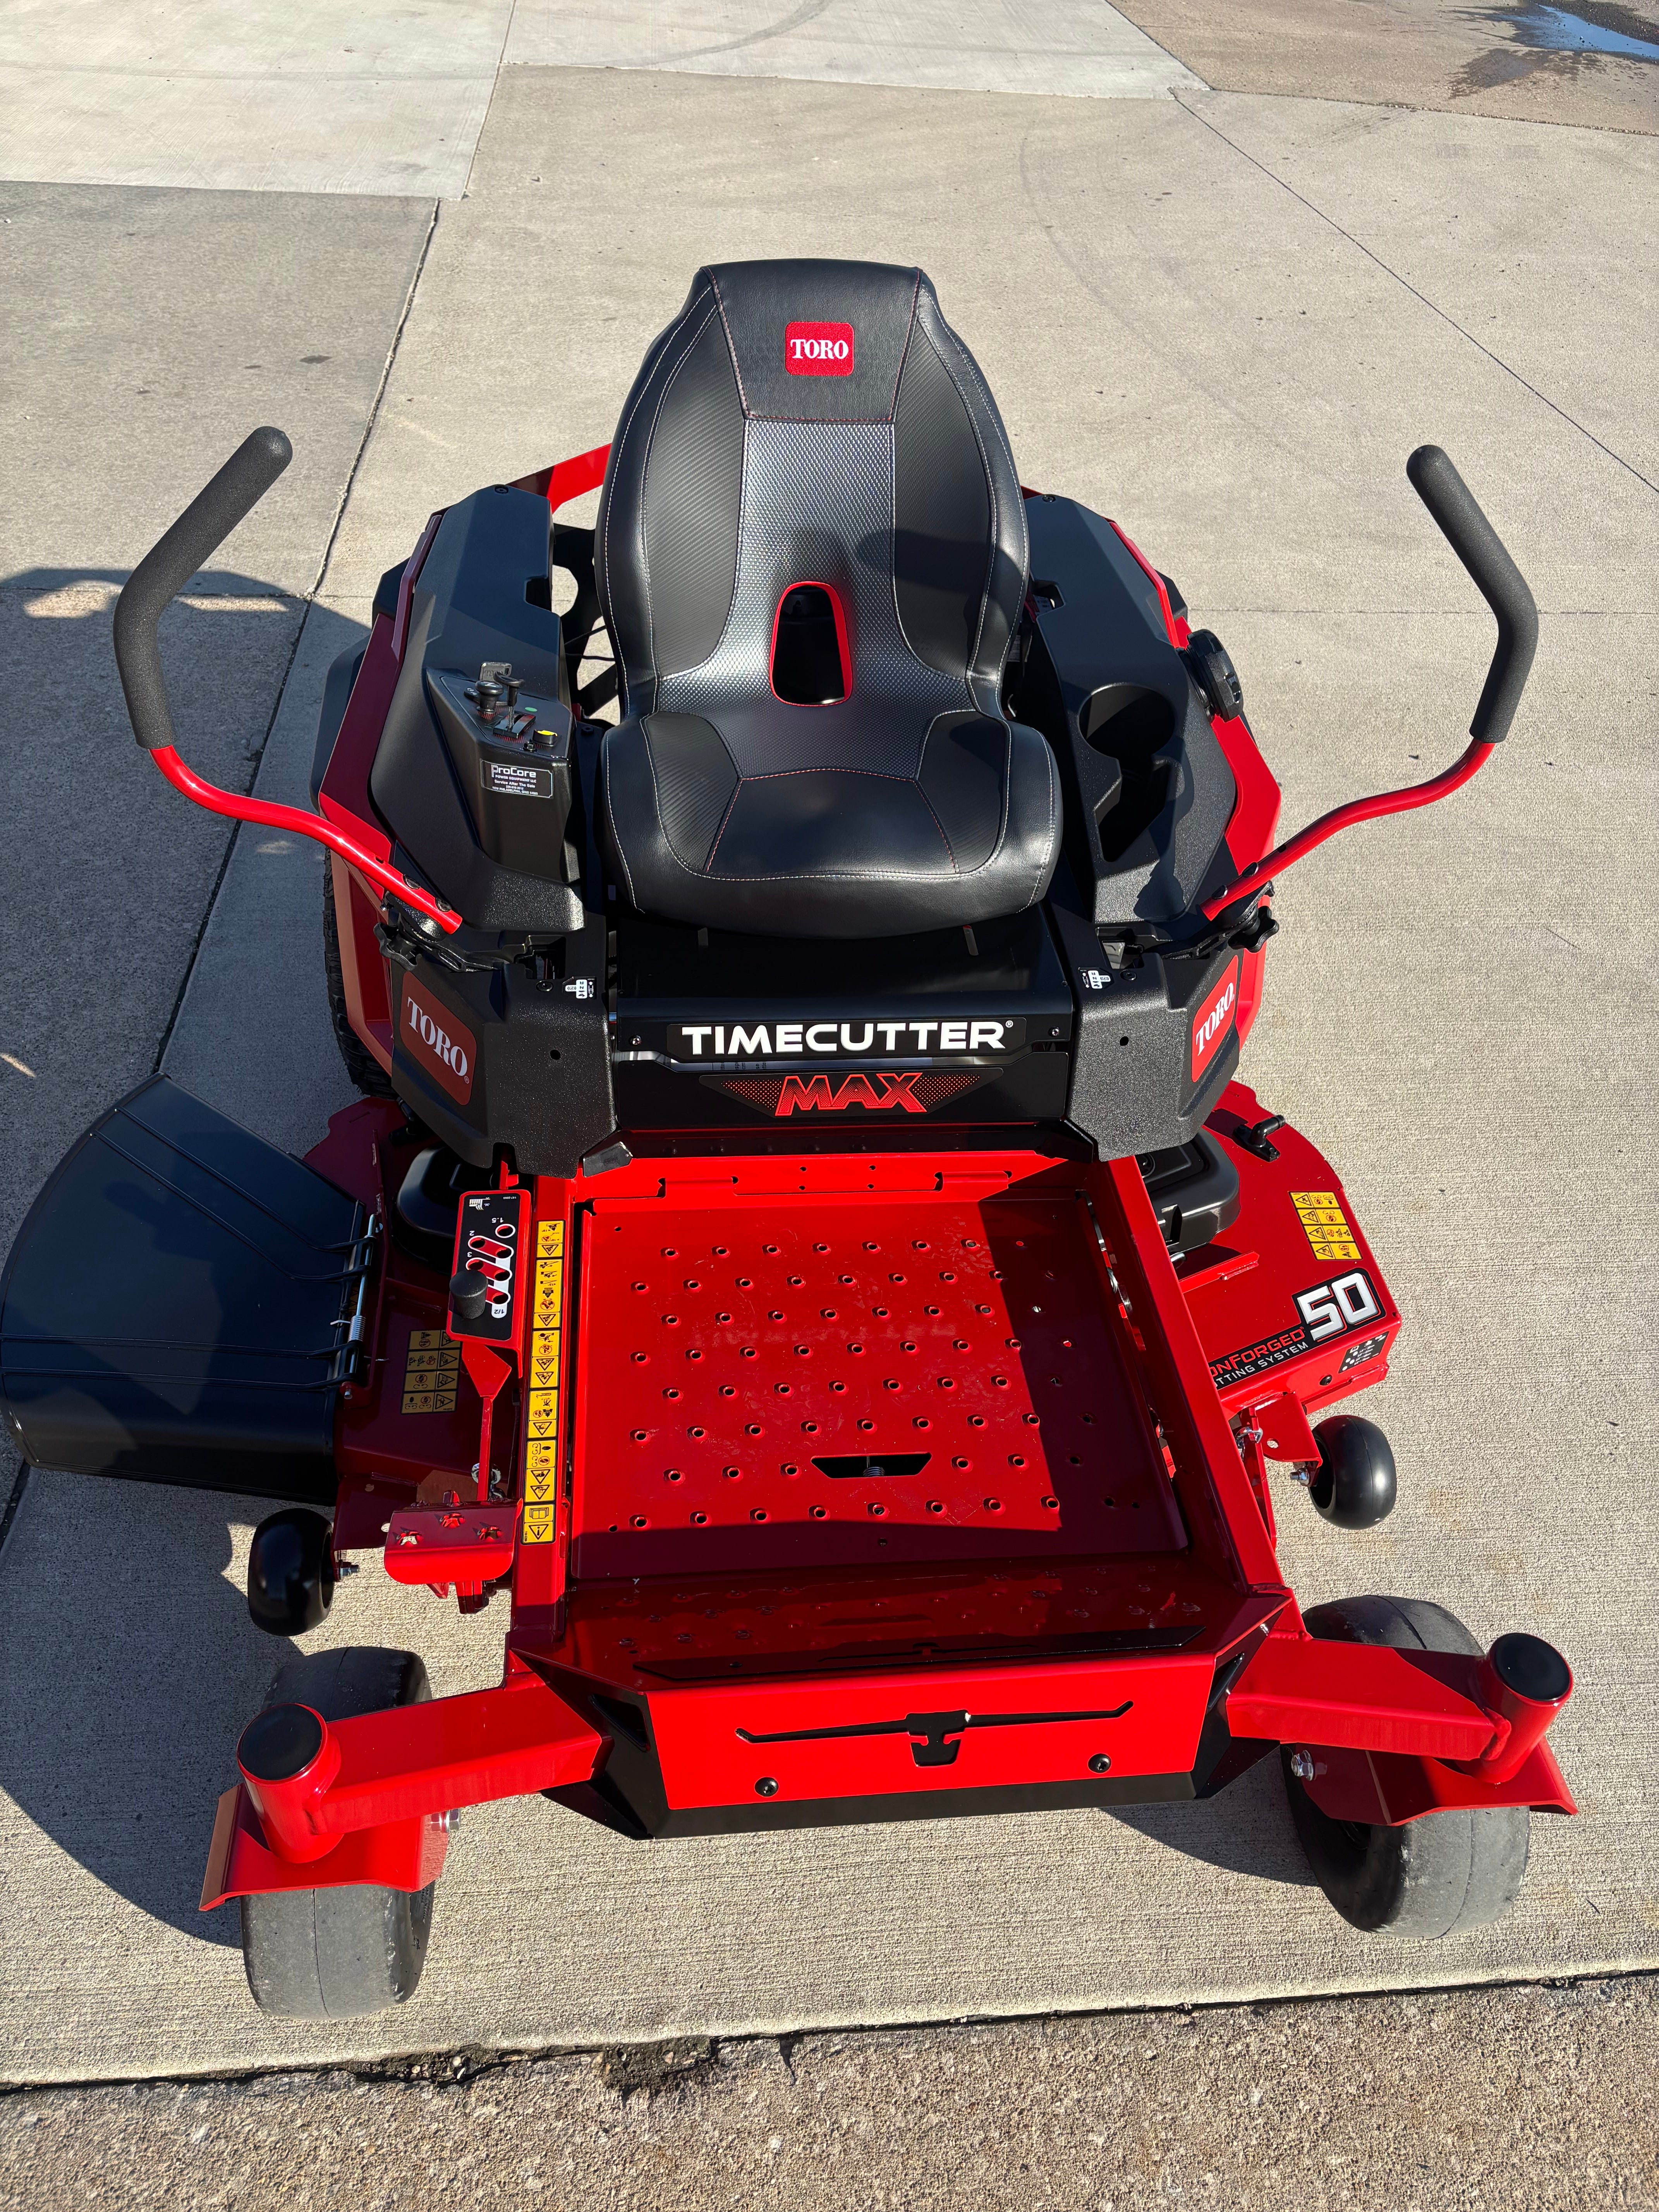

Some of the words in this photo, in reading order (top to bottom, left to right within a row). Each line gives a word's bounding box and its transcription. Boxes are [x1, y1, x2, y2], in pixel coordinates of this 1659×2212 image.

[790, 339, 849, 359] TORO
[491, 764, 536, 778] ProCore
[1196, 982, 1234, 1056] TORO
[775, 1072, 927, 1116] MAX
[1297, 1272, 1380, 1341] 50
[1257, 1341, 1308, 1367] SYSTEM
